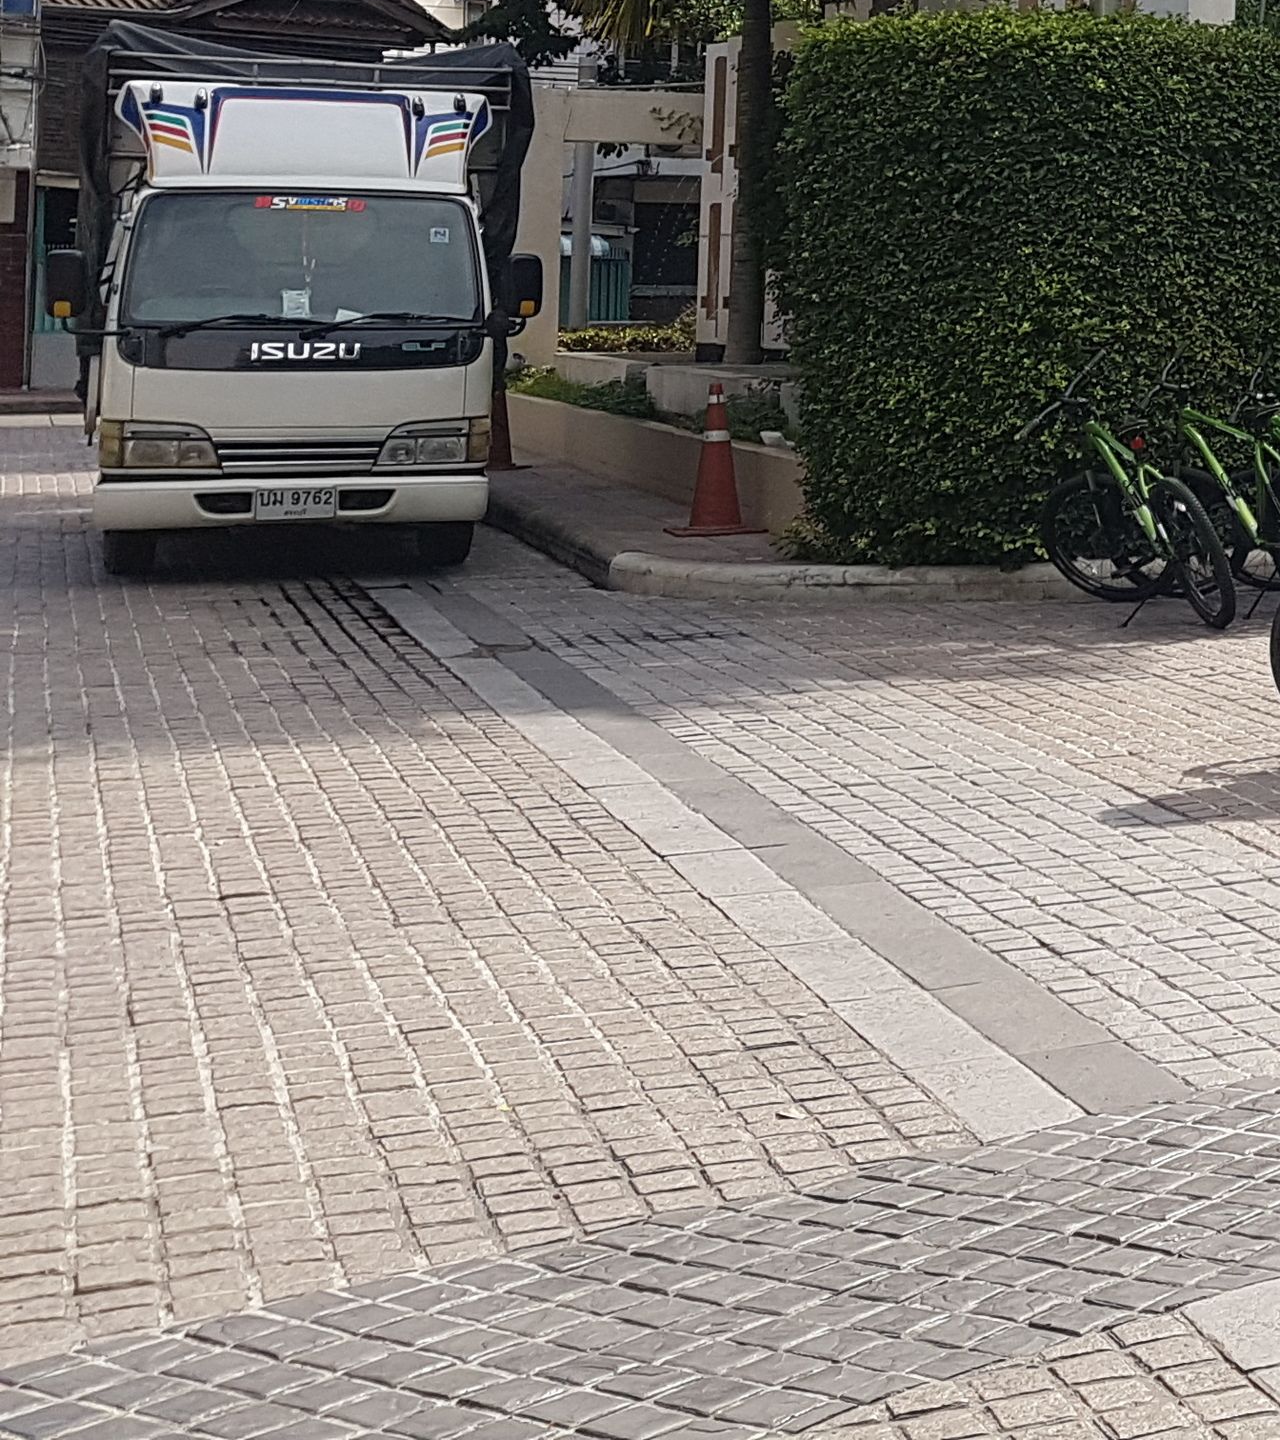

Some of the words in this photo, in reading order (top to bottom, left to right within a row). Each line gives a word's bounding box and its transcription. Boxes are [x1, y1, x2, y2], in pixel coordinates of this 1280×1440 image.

[250, 342, 361, 361] ISUZU
[259, 490, 284, 507] บม
[290, 490, 334, 506] 9762
